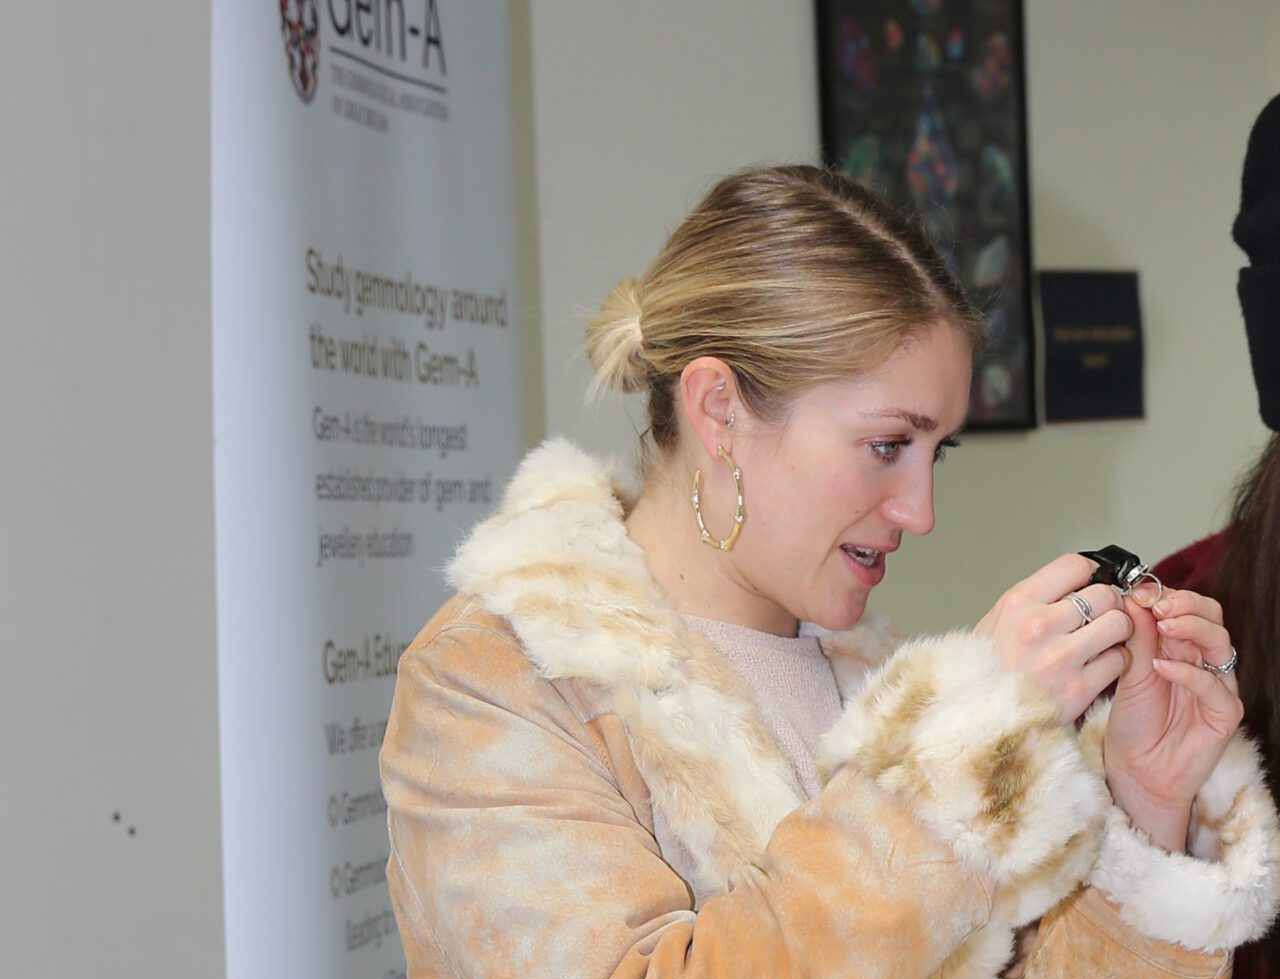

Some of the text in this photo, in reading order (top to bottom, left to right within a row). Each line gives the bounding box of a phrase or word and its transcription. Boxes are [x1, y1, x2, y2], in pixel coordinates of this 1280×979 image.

[305, 247, 508, 330] Study gemmology around
[309, 322, 480, 389] the world with Gem-A
[322, 635, 371, 684] Gem-A
